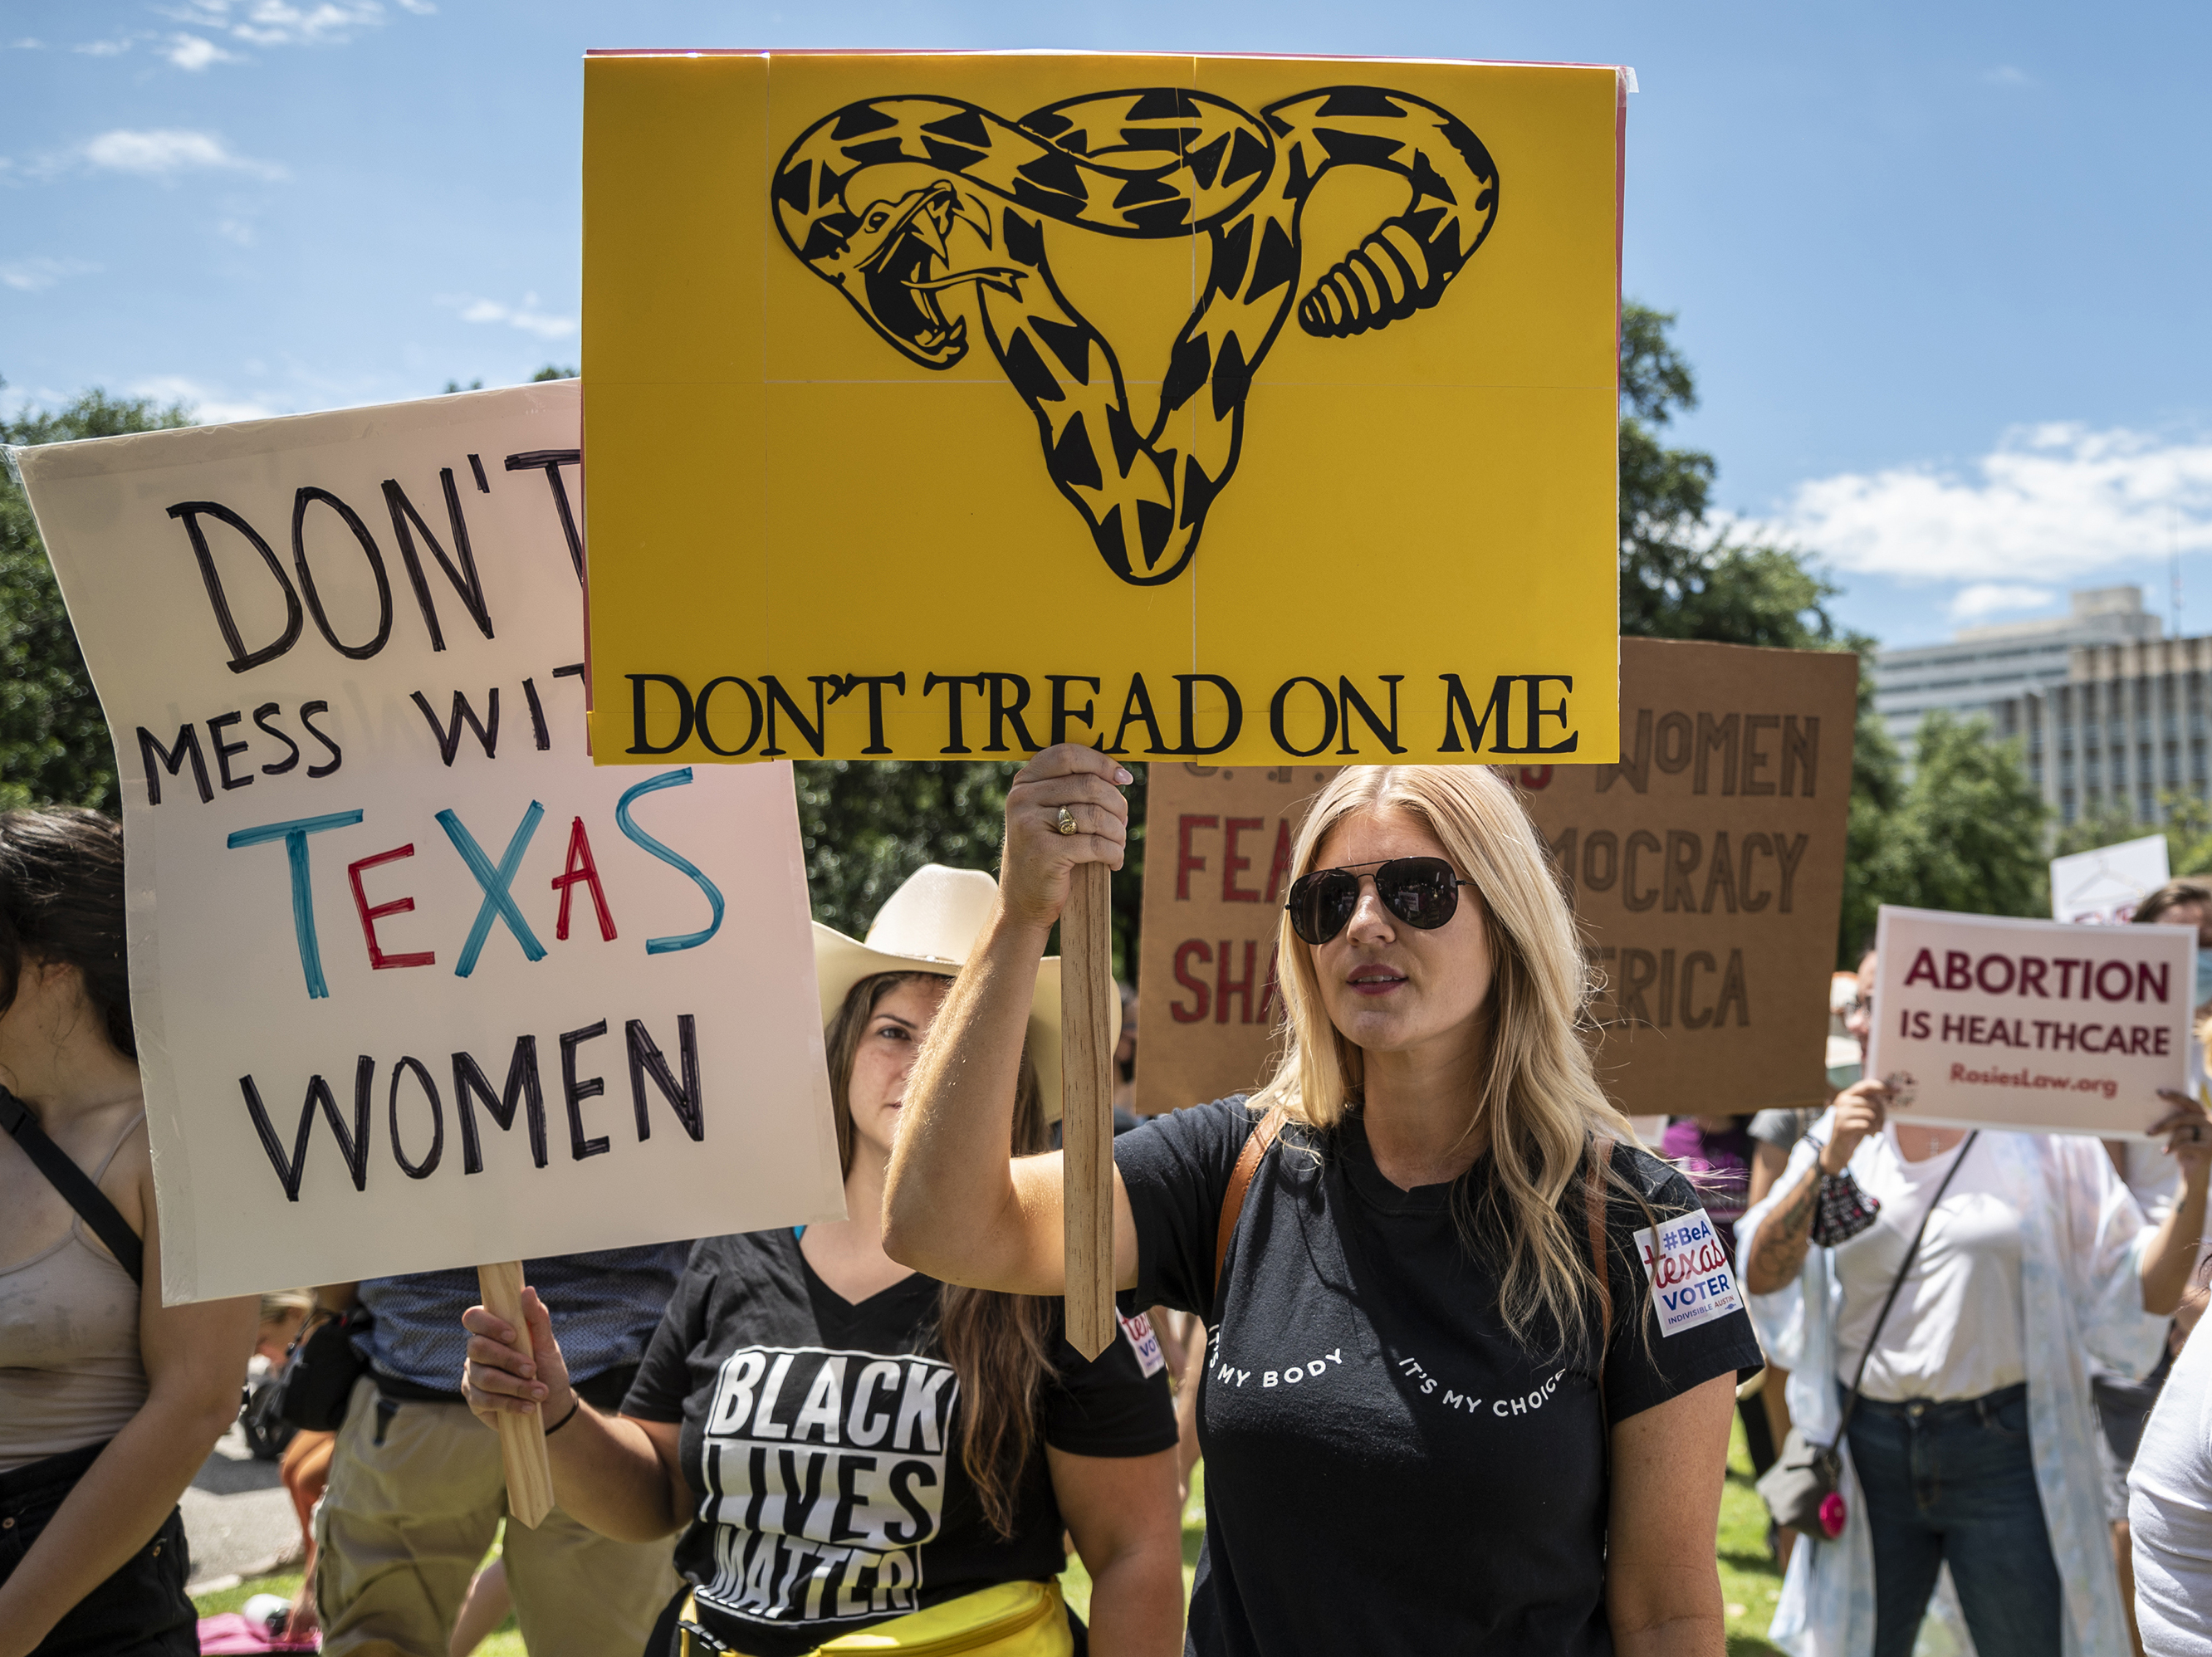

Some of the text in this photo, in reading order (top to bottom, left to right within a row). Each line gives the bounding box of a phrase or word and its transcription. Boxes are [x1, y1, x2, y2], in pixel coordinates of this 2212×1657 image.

[166, 449, 584, 674] DON'T
[624, 671, 1579, 757] DON'T TREAD ON ME
[136, 700, 342, 805] MESS
[228, 767, 725, 1000] TEXAS
[1904, 948, 2170, 1004] ABORTION
[1901, 1009, 2170, 1057] IS HEALTHCARE
[239, 1014, 704, 1201] WOMEN
[1950, 1063, 2118, 1098] RosiesLaw.org
[1644, 1239, 1726, 1288] texas
[1662, 1273, 1730, 1311] VOTER
[1668, 1295, 1735, 1325] INDIVISIBLE AUSTIN
[1139, 1335, 1159, 1356] VO
[1217, 1363, 1251, 1387] MY
[1263, 1348, 1343, 1388] BODY
[710, 1352, 954, 1452] BLACK
[1399, 1357, 1438, 1394] IT'S
[1442, 1390, 1481, 1413] MY
[707, 1444, 938, 1545] LIVES
[697, 1524, 915, 1619] MATTER
